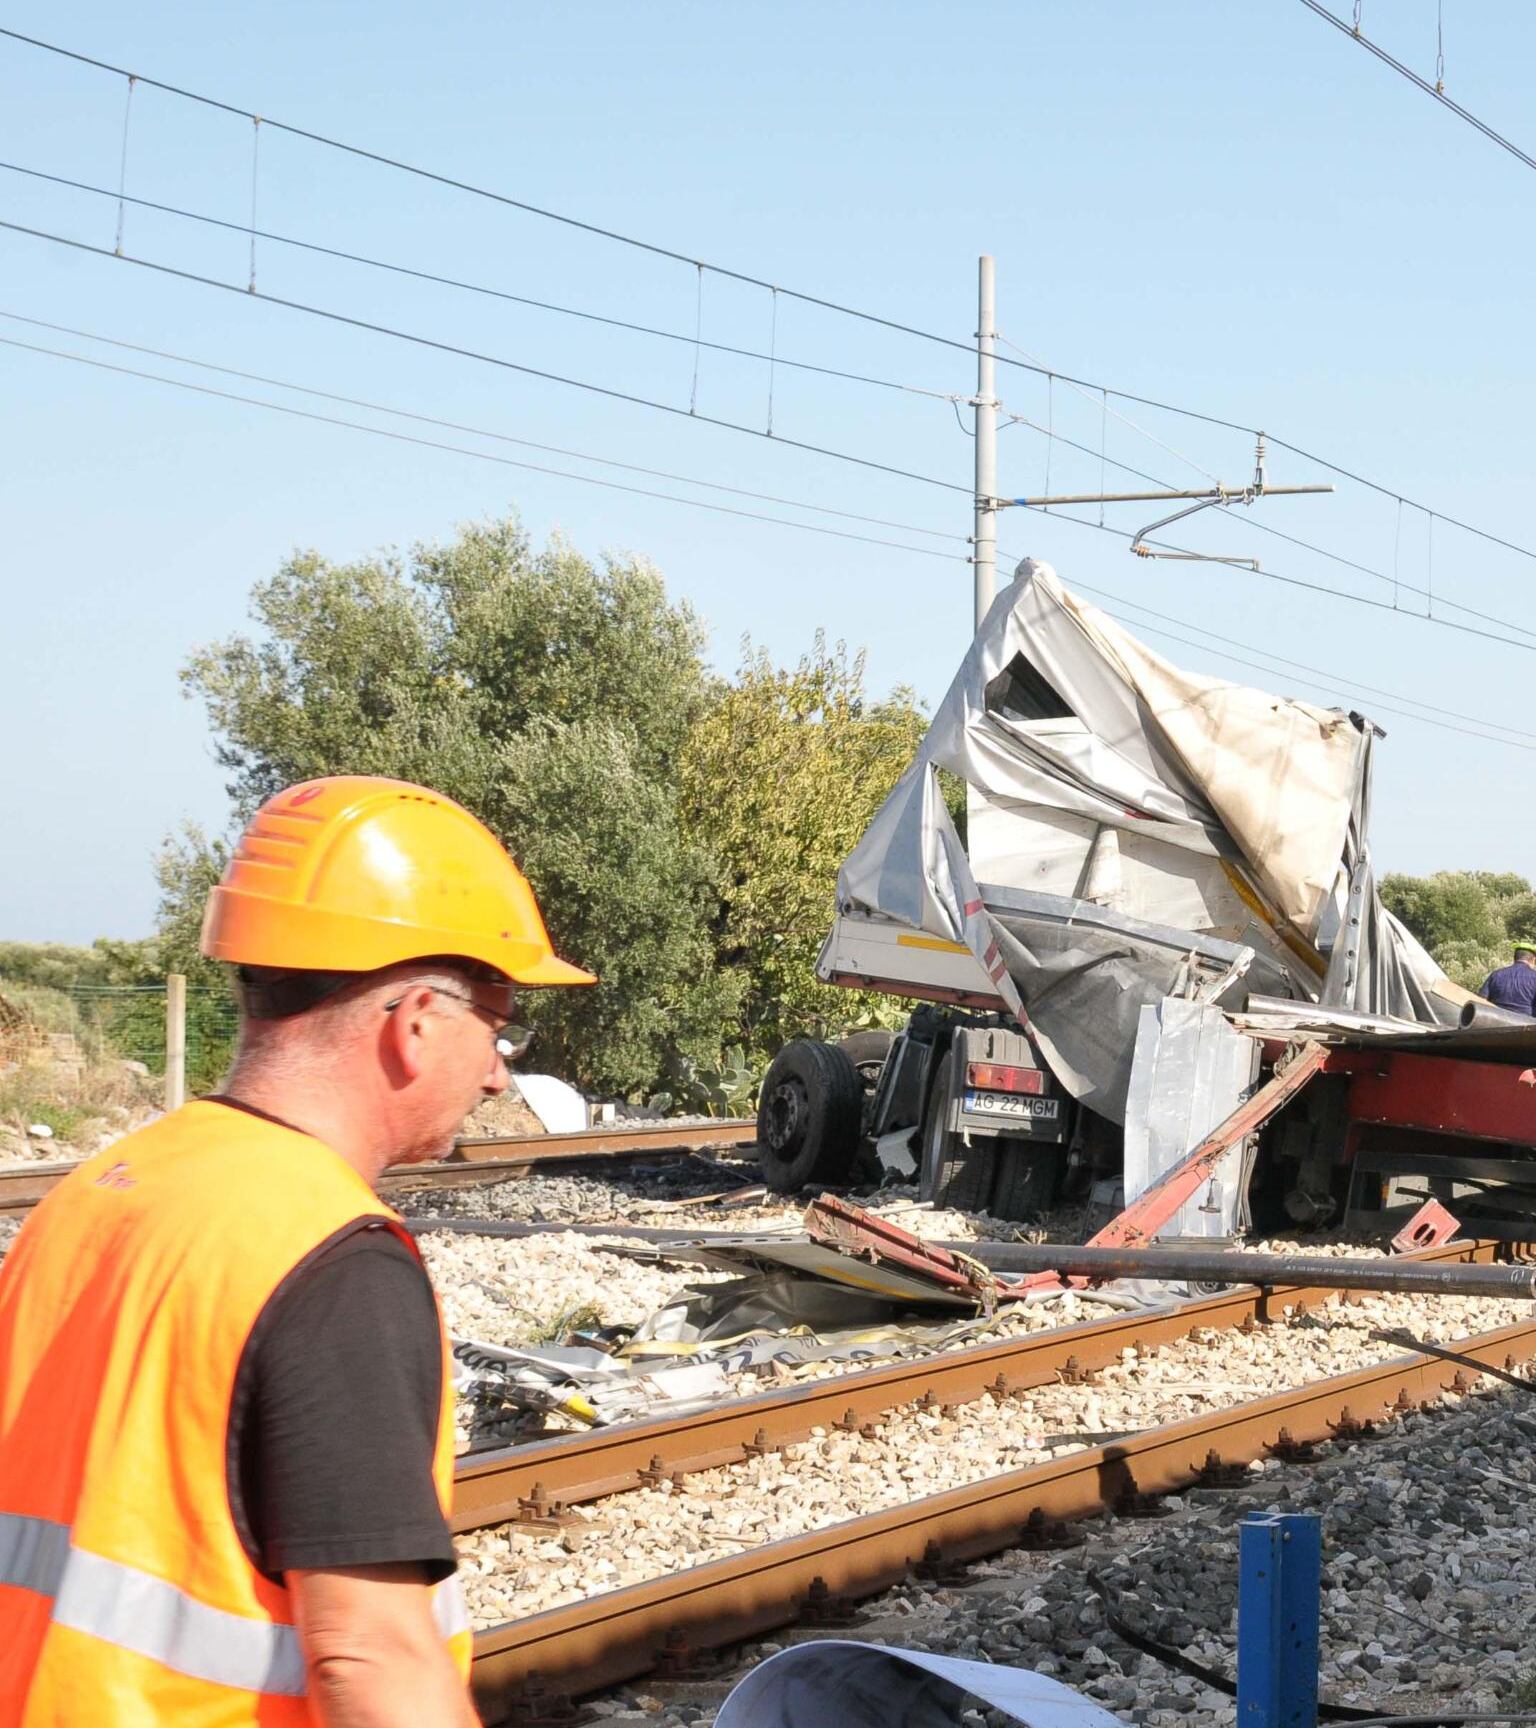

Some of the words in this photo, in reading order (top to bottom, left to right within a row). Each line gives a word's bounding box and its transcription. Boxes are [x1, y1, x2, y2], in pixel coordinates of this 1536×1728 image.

[974, 1093, 995, 1110] AG
[1000, 1096, 1018, 1113] 22
[1022, 1099, 1055, 1117] MGM
